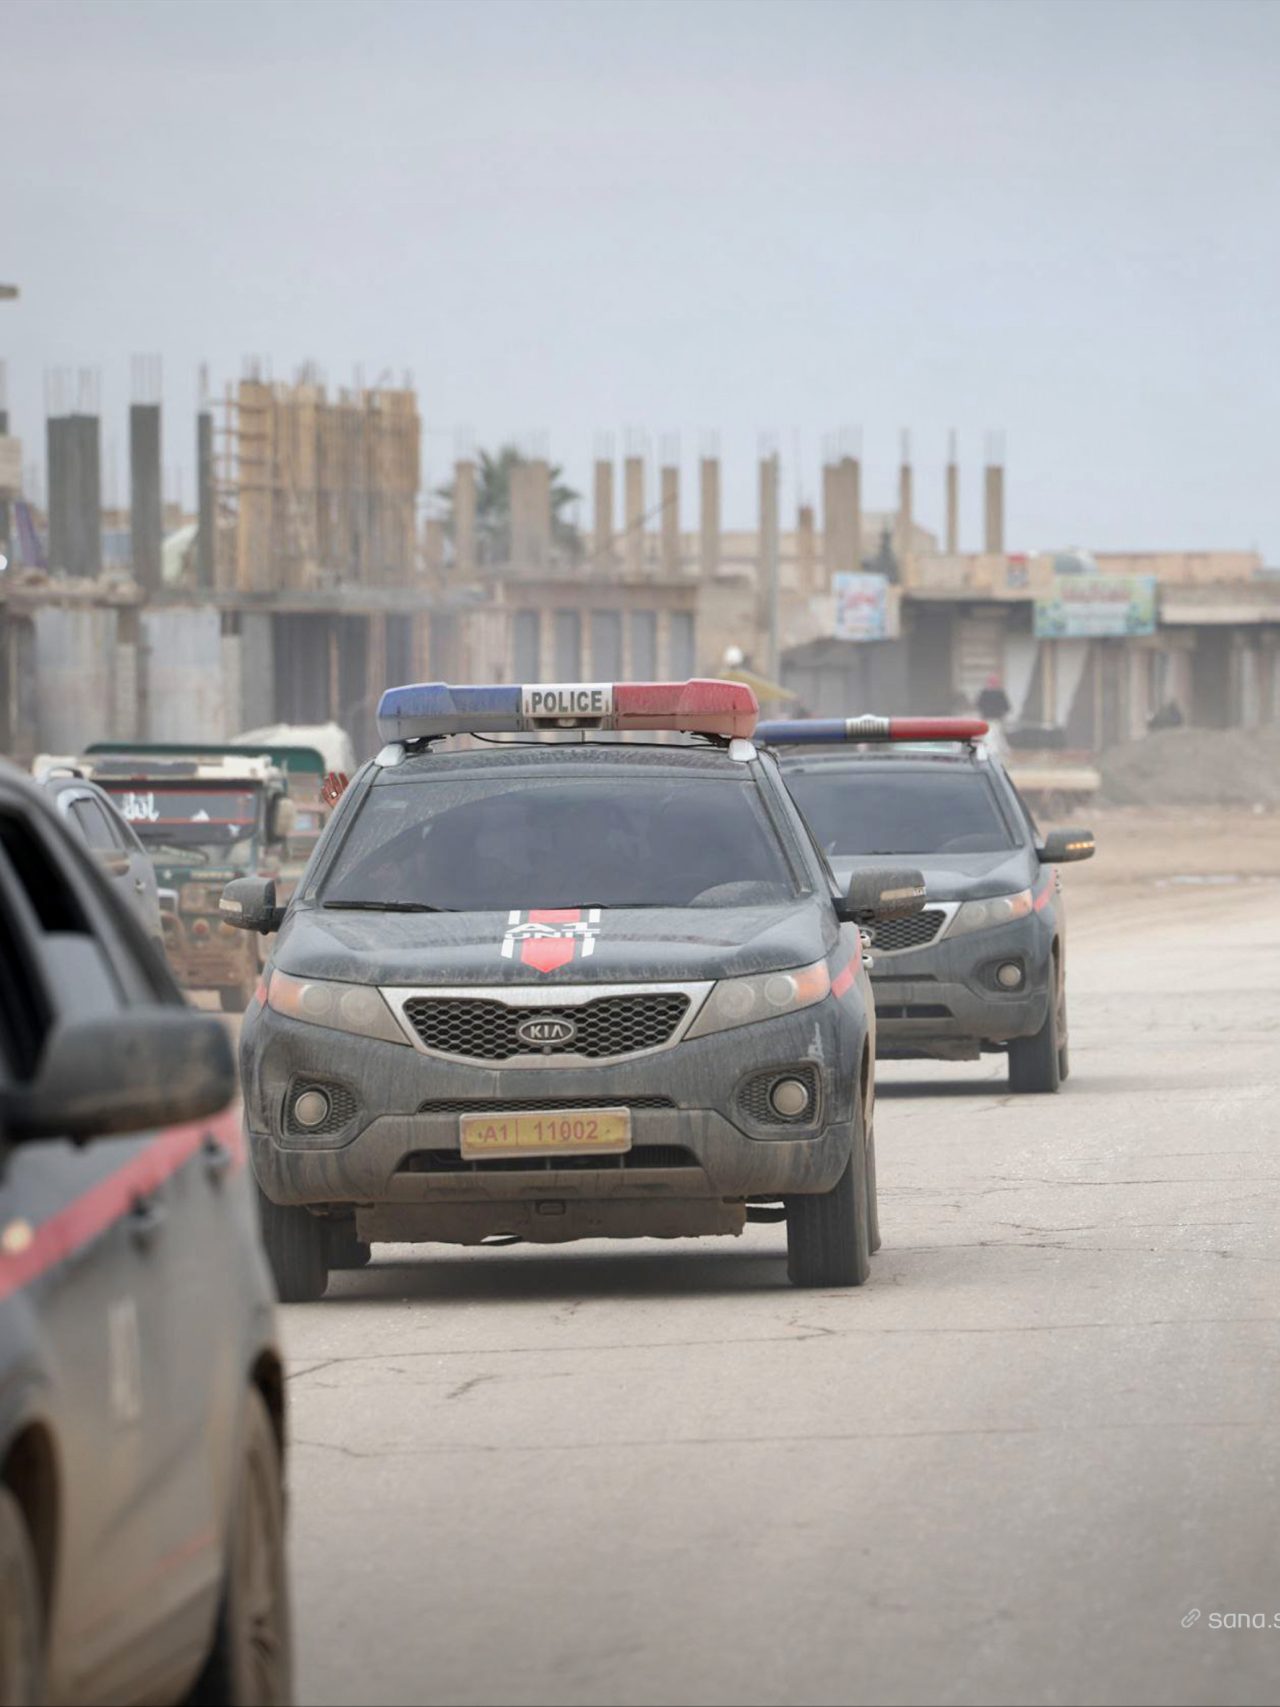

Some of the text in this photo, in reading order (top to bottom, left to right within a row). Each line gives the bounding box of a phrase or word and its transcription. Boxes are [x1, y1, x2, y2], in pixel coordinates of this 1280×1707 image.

[531, 690, 603, 713] POLICE
[505, 921, 601, 932] A1
[504, 931, 601, 940] UNIT
[529, 1024, 564, 1039] KIA
[483, 1120, 599, 1142] A1 11002
